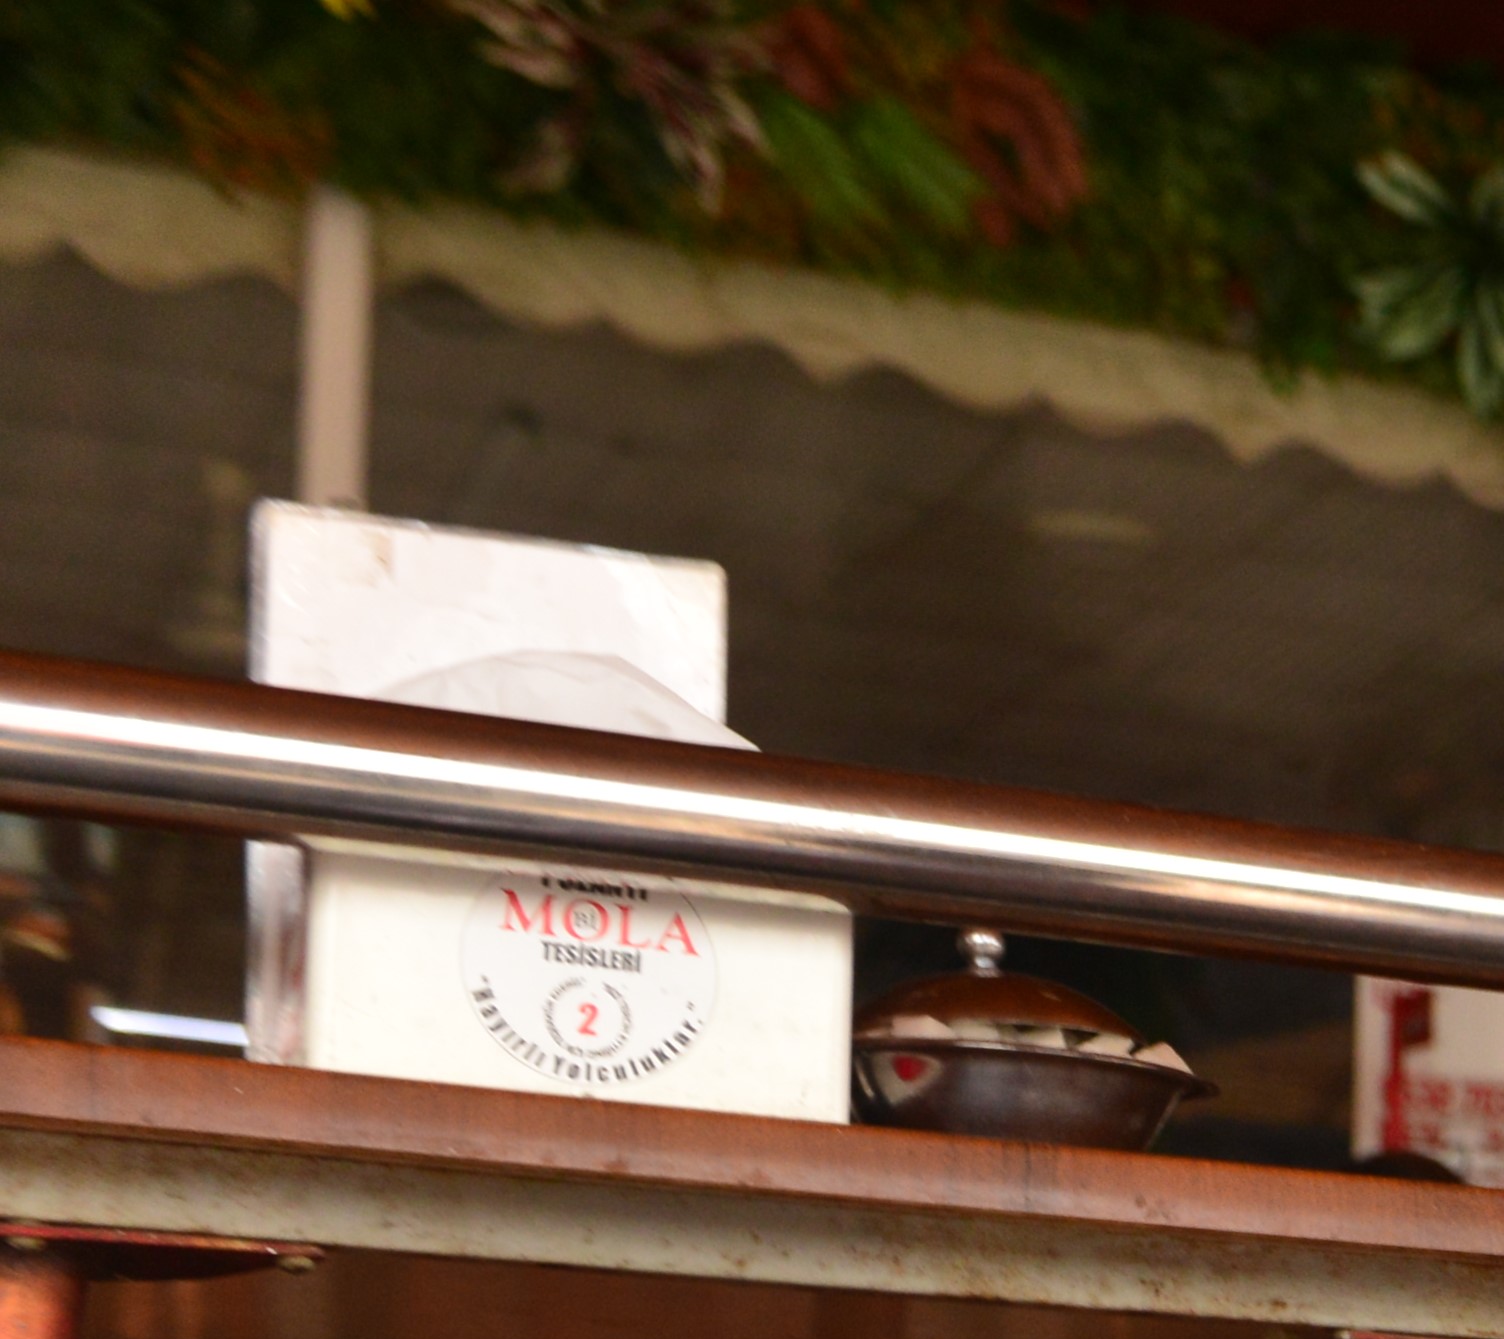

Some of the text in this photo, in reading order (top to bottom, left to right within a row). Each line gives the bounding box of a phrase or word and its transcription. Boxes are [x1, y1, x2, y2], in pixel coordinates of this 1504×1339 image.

[500, 886, 700, 958] MOLA
[541, 938, 642, 974] TESİSLERİ
[577, 1002, 600, 1037] 2
